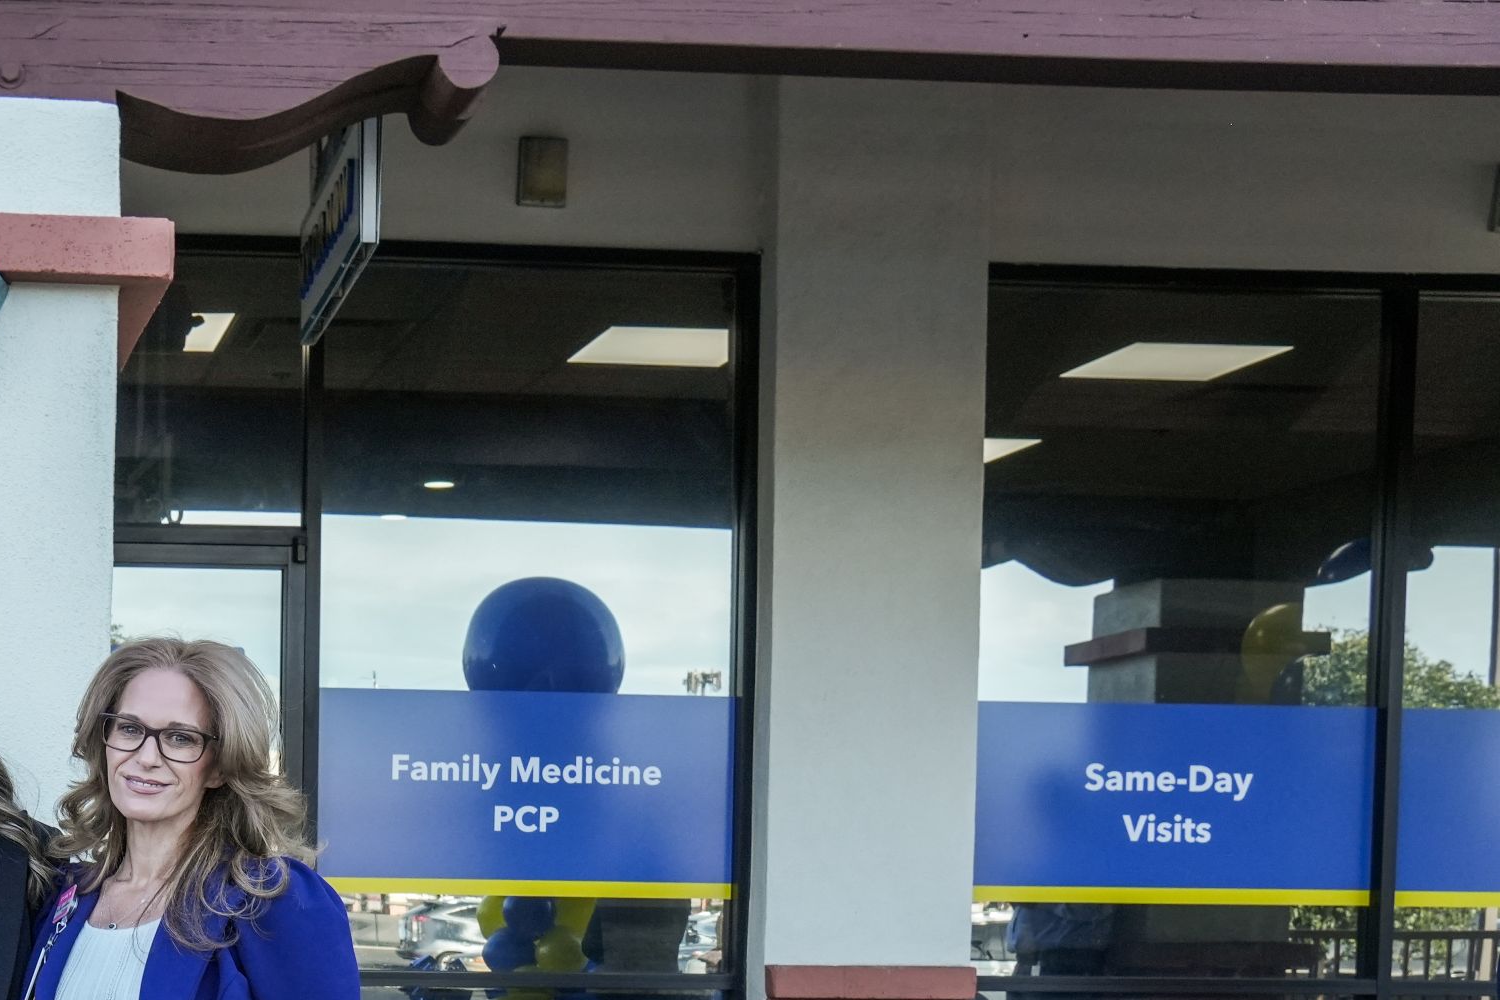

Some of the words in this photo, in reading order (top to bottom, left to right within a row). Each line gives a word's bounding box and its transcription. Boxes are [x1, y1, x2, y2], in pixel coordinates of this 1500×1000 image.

[391, 753, 501, 790] Family
[510, 756, 662, 786] Medicine
[1085, 763, 1254, 801] Same-Day
[493, 805, 560, 833] PCP
[1122, 814, 1212, 843] Visits
